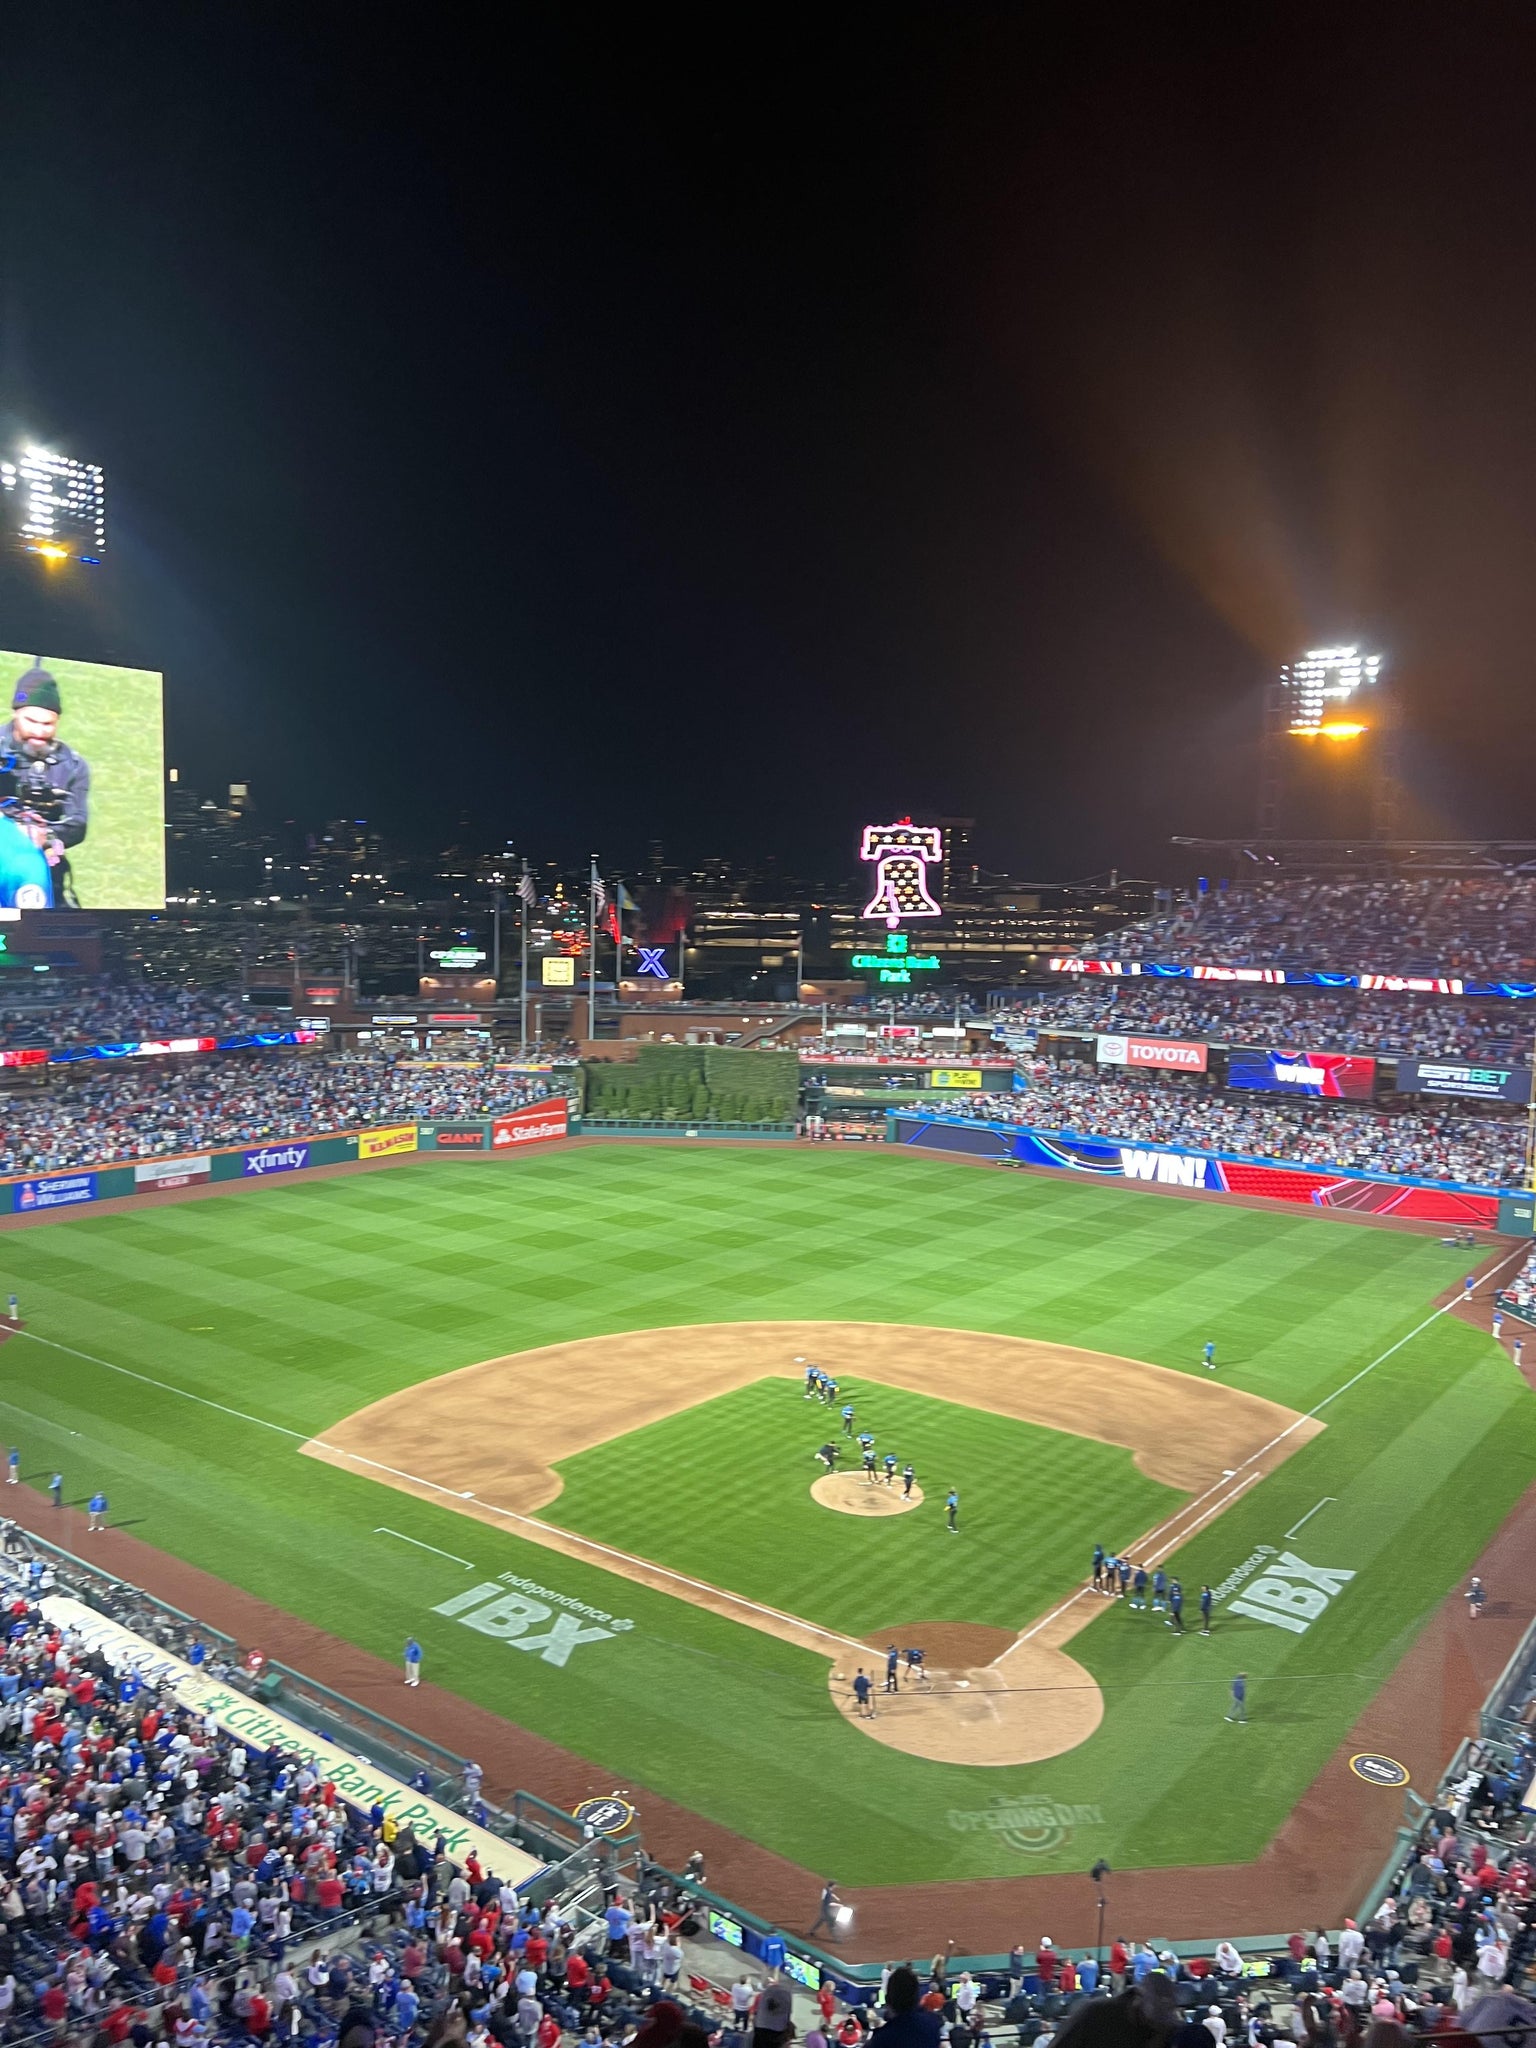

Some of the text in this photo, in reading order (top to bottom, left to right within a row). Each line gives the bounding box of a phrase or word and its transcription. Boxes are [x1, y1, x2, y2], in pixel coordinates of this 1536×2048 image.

[852, 954, 941, 969] Citizens Bank
[880, 969, 911, 983] Park
[1130, 1044, 1201, 1064] TOYOTA
[1470, 1069, 1512, 1085] BET
[437, 1133, 484, 1144] GIANT
[247, 1147, 307, 1174] xfinity
[1120, 1148, 1207, 1188] WIN!
[37, 1177, 91, 1194] SHERWIN
[497, 1571, 613, 1622] Independence
[1226, 1551, 1358, 1634] IBX
[429, 1581, 617, 1667] IBX
[326, 1762, 403, 1811] Bank
[395, 1803, 470, 1853] Park
